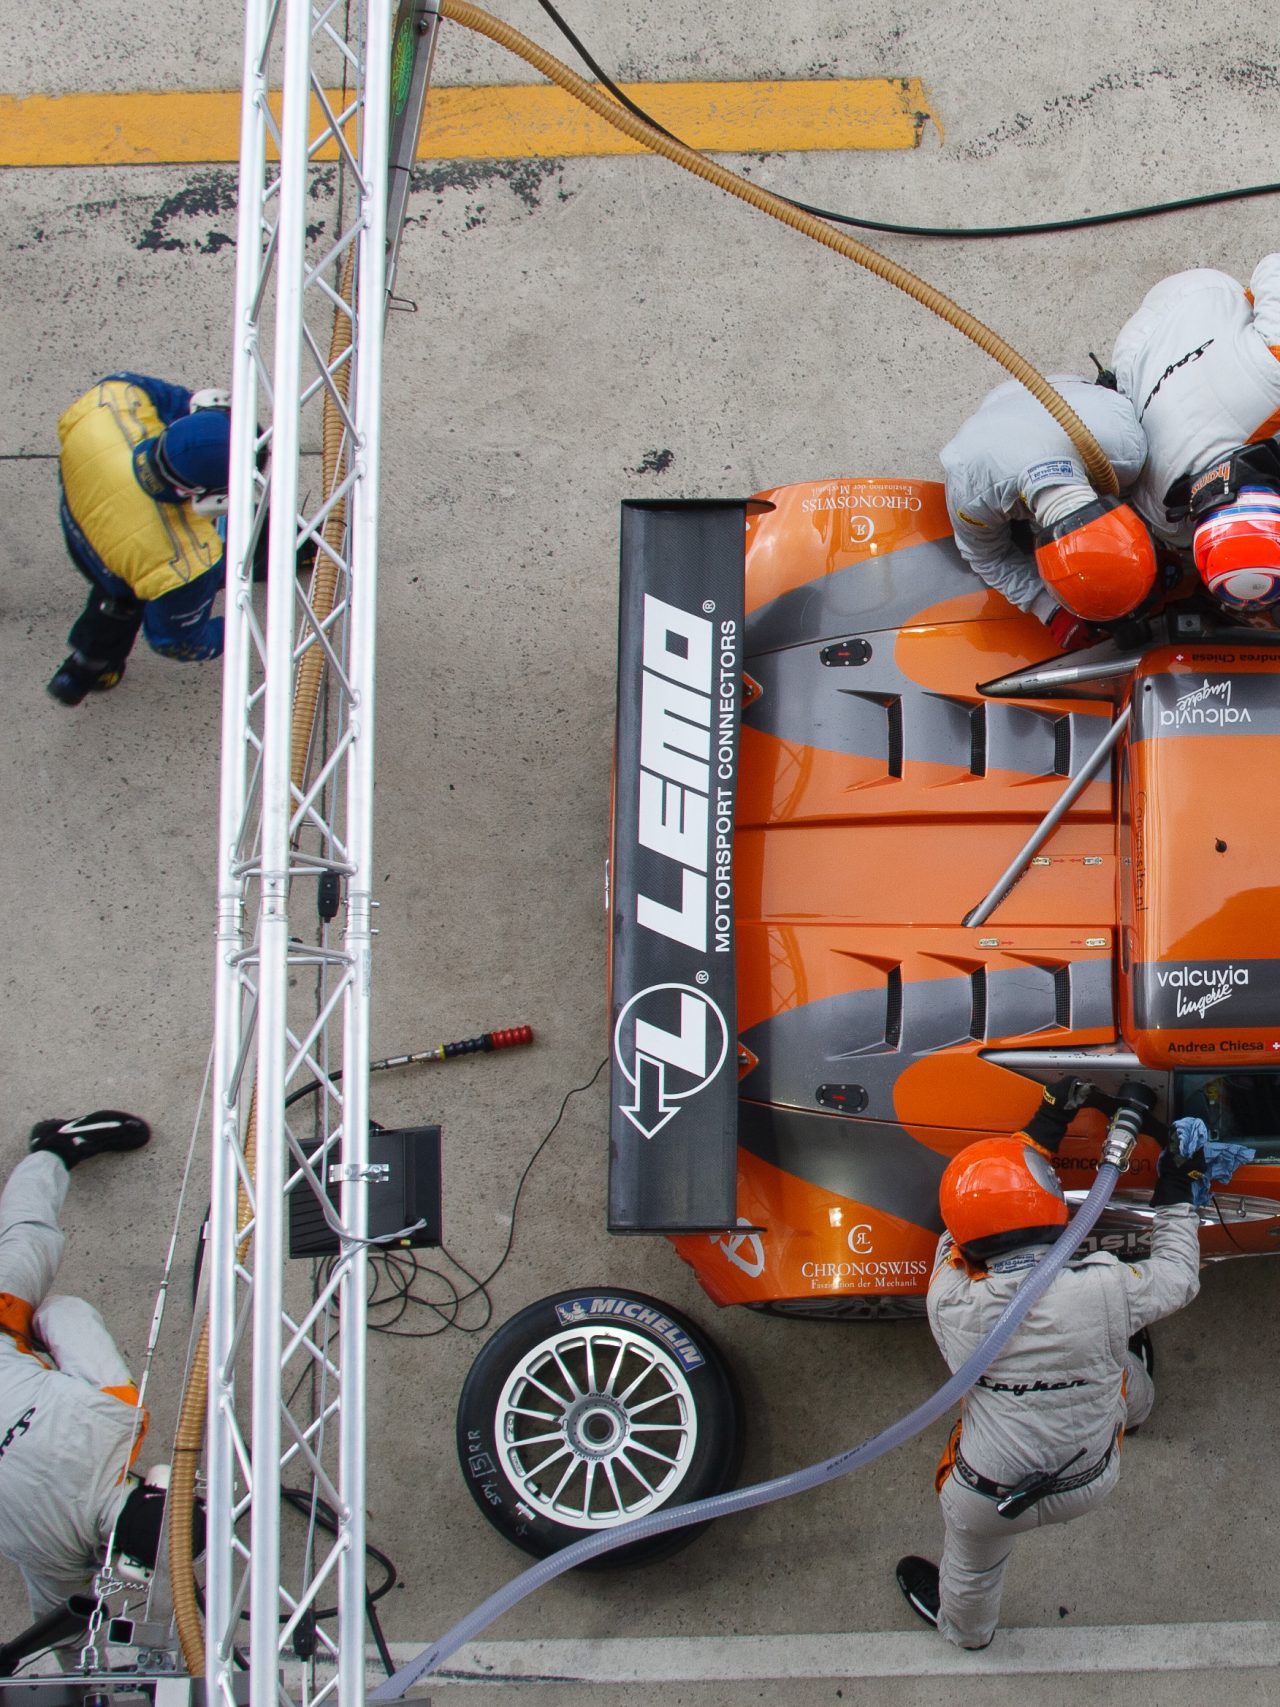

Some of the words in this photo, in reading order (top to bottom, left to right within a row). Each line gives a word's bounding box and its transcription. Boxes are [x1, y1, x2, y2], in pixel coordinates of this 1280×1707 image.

[802, 495, 922, 513] CHRONOSWISS
[1191, 653, 1236, 663] Chiesa
[717, 618, 736, 780] CONNECTORS
[1160, 708, 1252, 728] valcuvia
[637, 593, 713, 953] LEMO
[715, 787, 733, 952] MOTORSPORT
[1157, 965, 1249, 988] valcuvia
[1168, 1041, 1216, 1053] Andrea
[1219, 1040, 1264, 1051] Chiesa
[801, 1261, 927, 1278] CHRONOSWISS
[858, 1278, 871, 1288] der
[875, 1277, 917, 1288] Mechanik
[590, 1298, 703, 1367] MICHELIN
[974, 1375, 1089, 1396] Spyker
